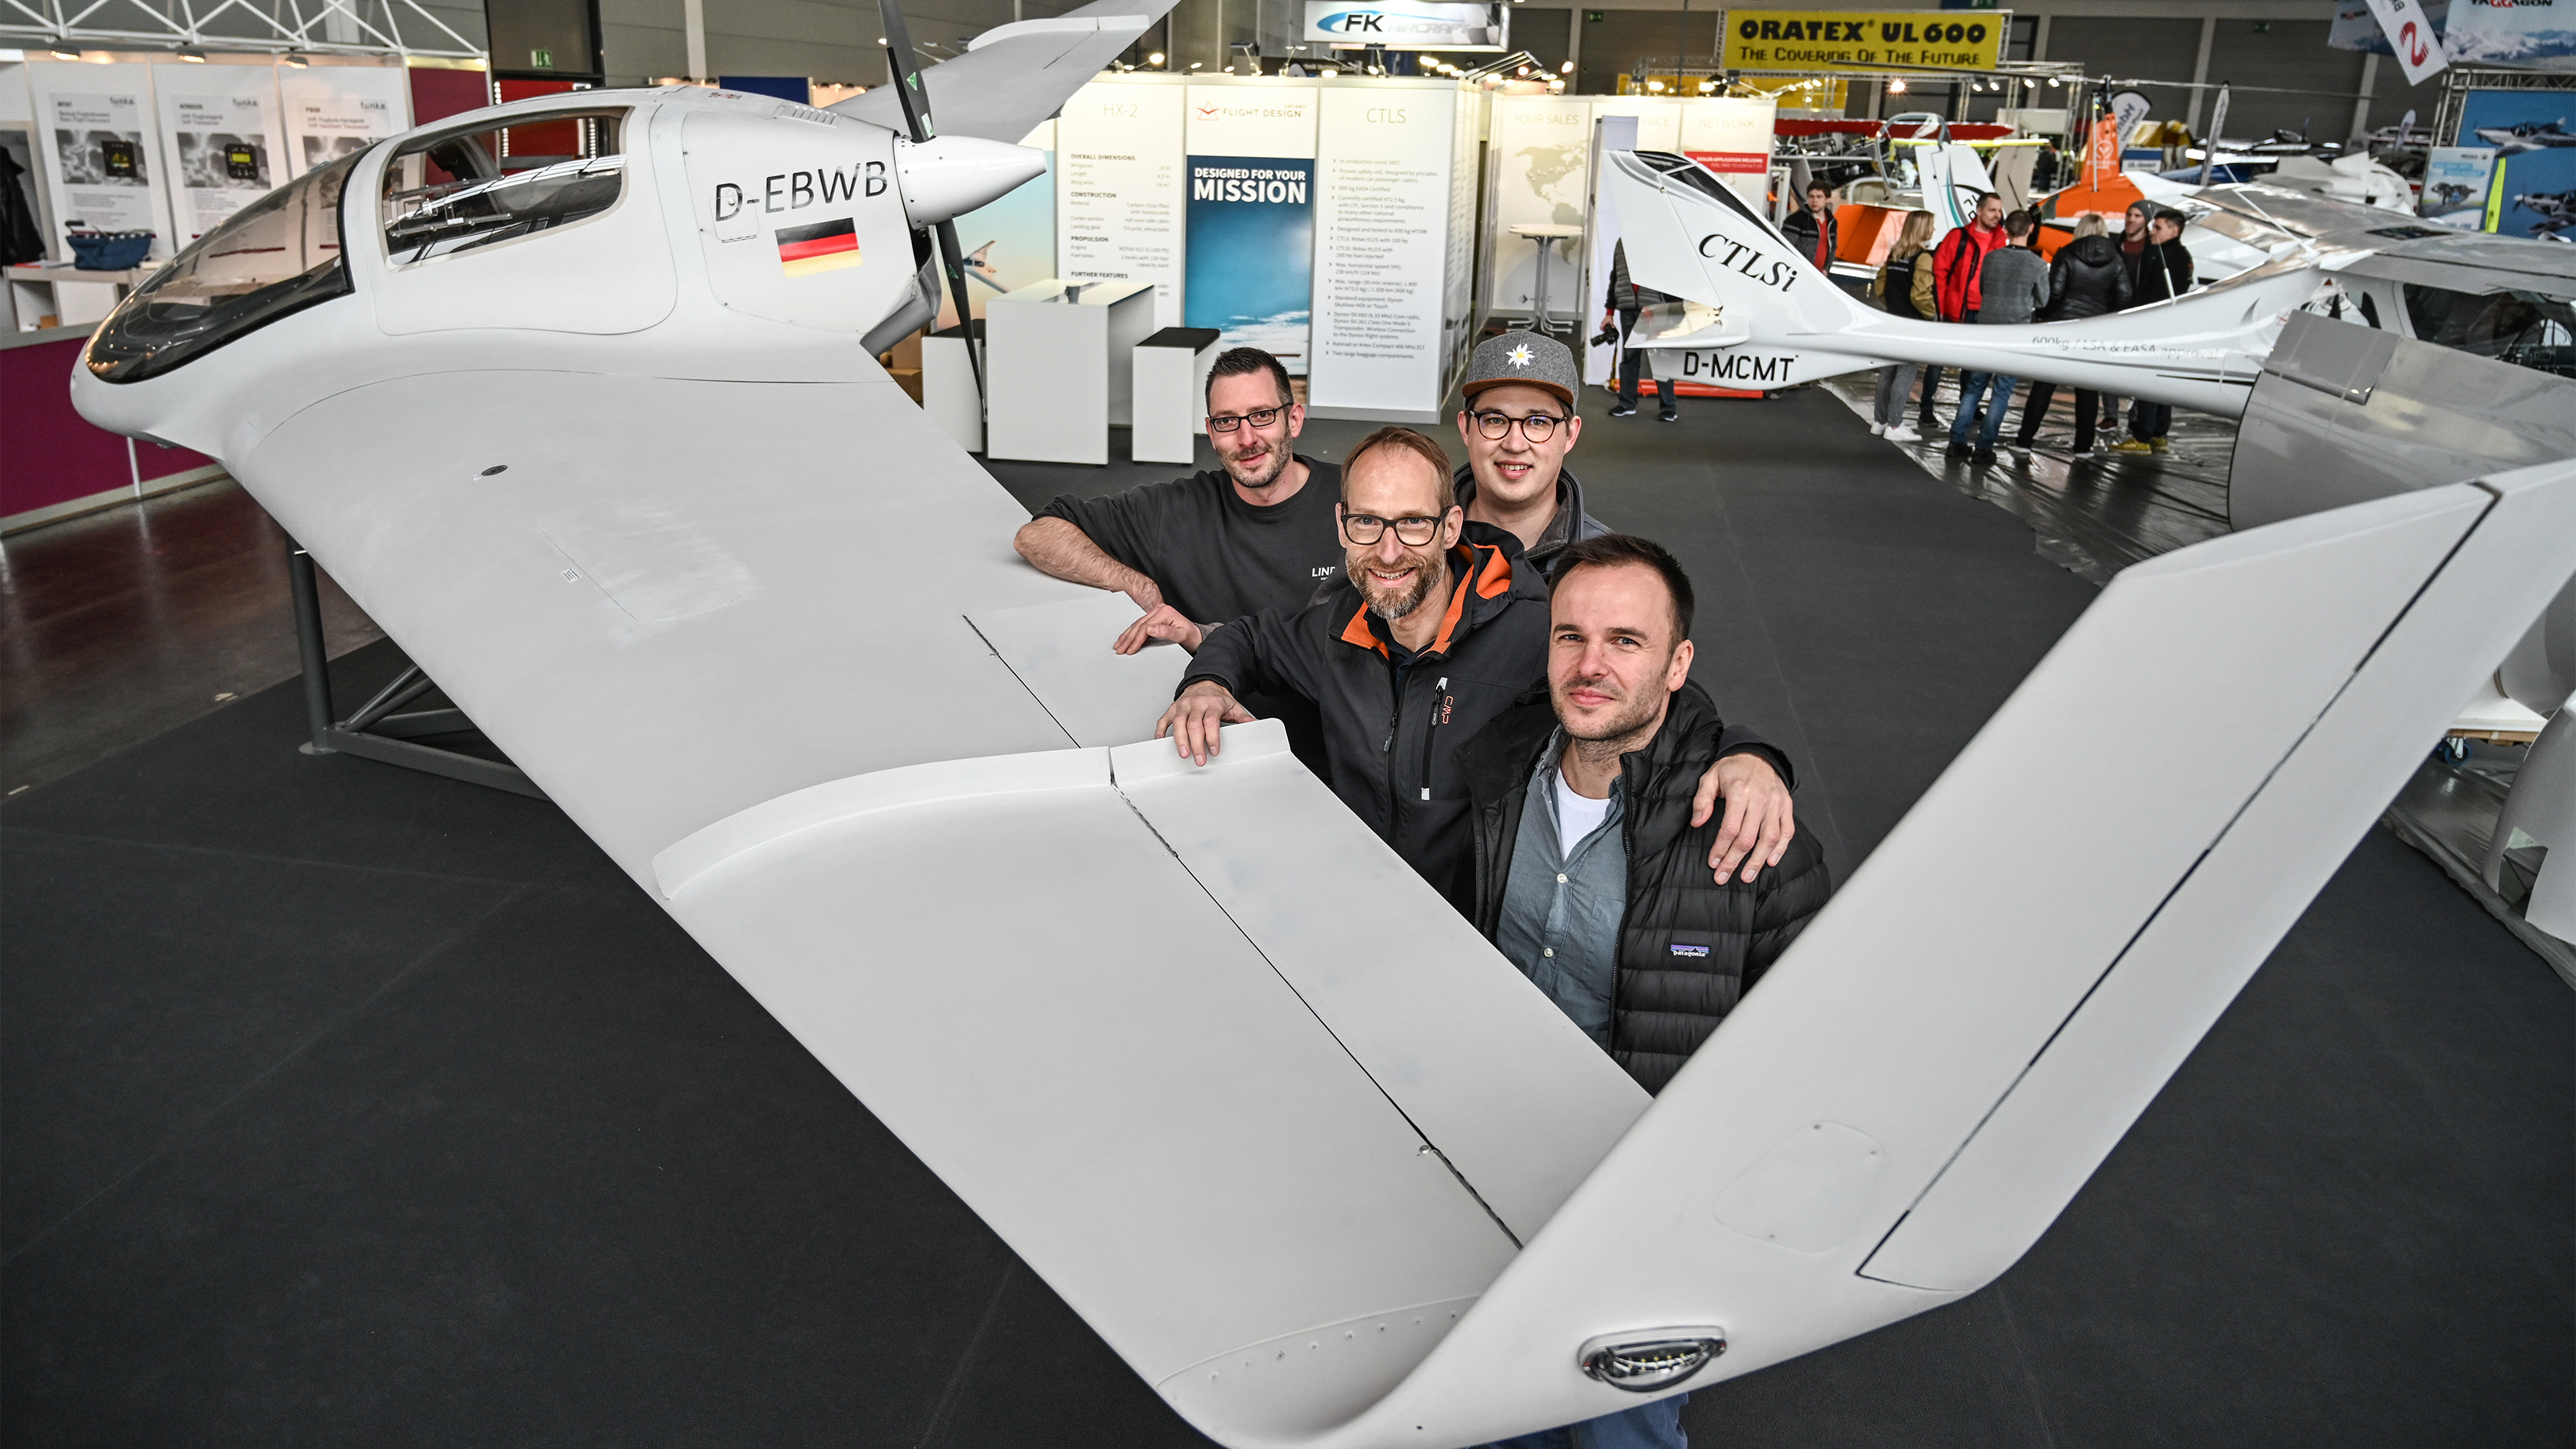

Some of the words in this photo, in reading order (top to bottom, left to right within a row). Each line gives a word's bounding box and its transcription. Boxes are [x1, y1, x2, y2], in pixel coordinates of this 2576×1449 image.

[1344, 14, 1384, 32] FK
[1388, 23, 1472, 34] AIRCRAFT
[1104, 103, 1138, 118] HX-2
[1223, 108, 1259, 117] FLIGHT
[1263, 109, 1302, 118] DESIGN
[1366, 108, 1406, 124] CTLS
[1514, 114, 1543, 125] YOUR
[1546, 115, 1579, 126] SALES
[1640, 117, 1670, 127] RVICE
[1699, 118, 1755, 129] NETWORK
[1195, 167, 1249, 180] DESIGNED
[1251, 169, 1274, 180] FOR
[1274, 170, 1306, 181] YOUR
[716, 161, 888, 221] D-EBWB
[1195, 179, 1307, 204] MISSION
[1699, 233, 1798, 292] CTLSi
[2123, 343, 2157, 355] EASA
[1683, 352, 1794, 382] D-MCMT
[1442, 696, 1454, 724] CMP
